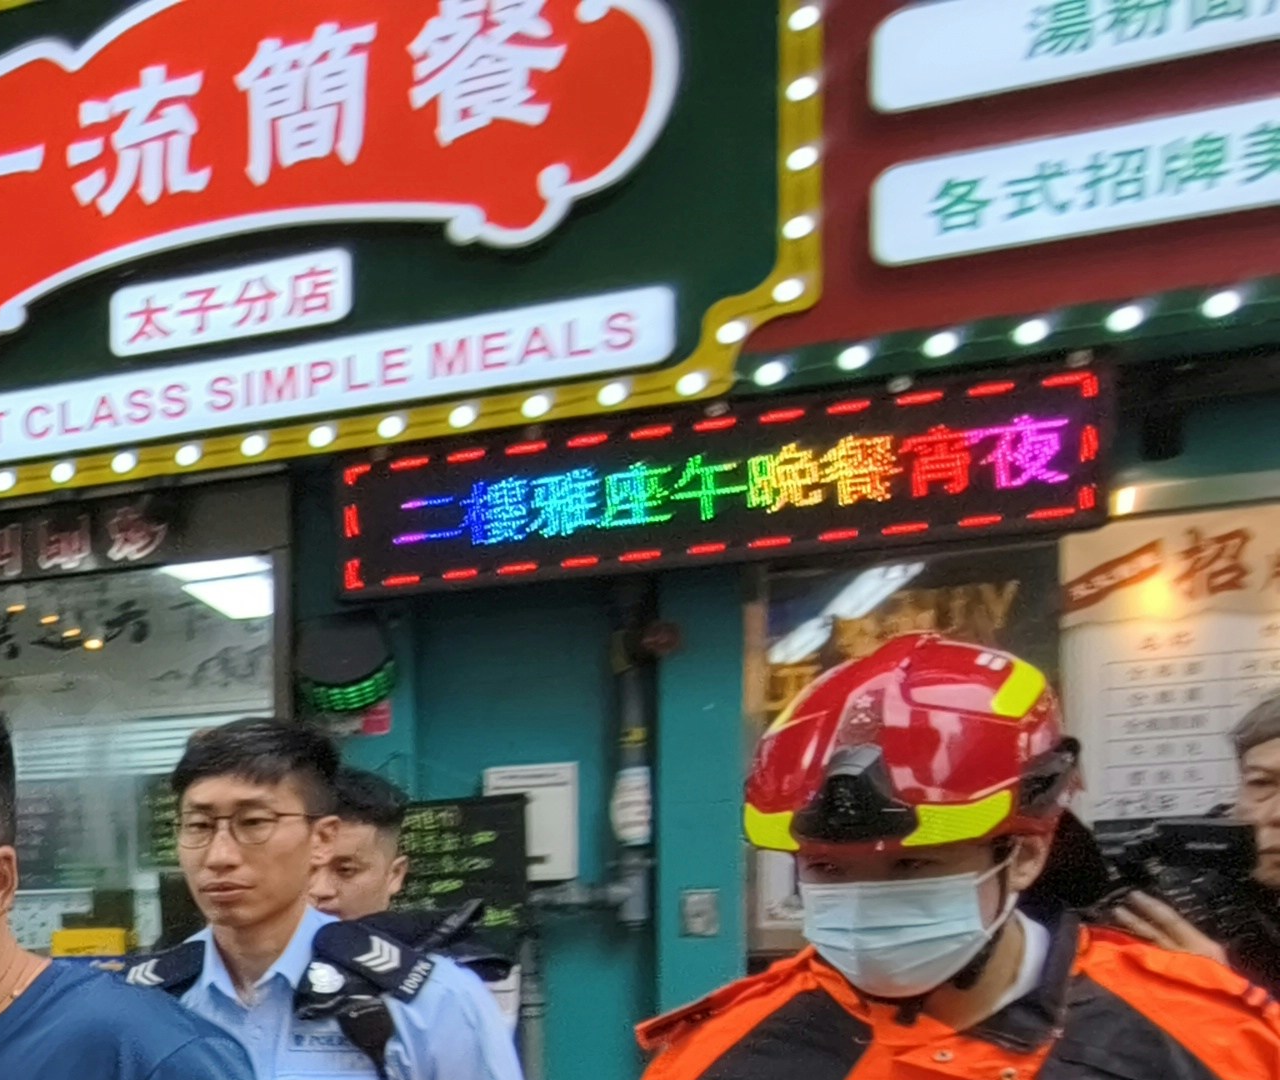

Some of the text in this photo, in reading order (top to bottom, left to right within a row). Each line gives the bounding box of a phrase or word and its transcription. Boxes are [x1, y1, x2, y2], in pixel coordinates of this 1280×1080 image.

[126, 267, 336, 345] 太子分店
[21, 383, 189, 440] CLASS
[206, 344, 411, 412] SIMPLE
[429, 311, 638, 380] MEALS
[392, 414, 1071, 546] 二樓雅座午晚餐宵夜
